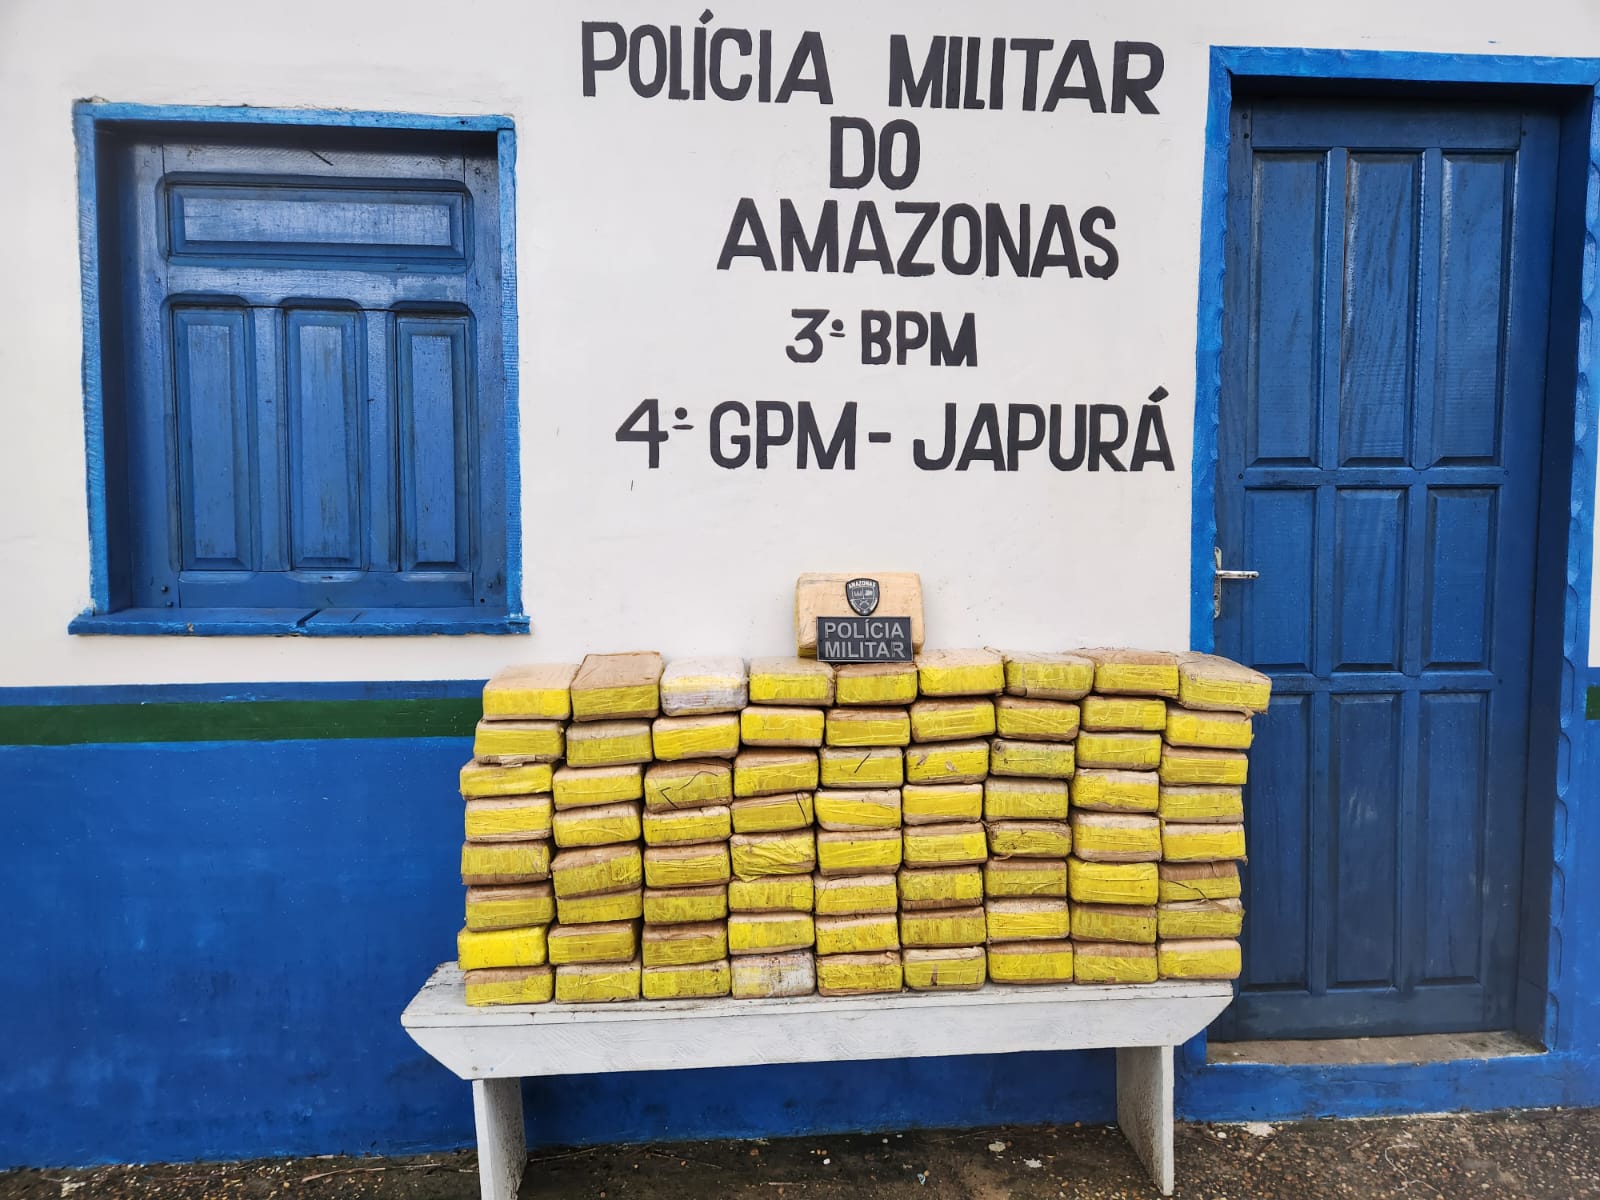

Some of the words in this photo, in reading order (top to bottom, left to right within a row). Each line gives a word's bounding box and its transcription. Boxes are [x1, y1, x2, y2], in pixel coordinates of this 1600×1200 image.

[582, 9, 833, 104] POLÍCIA
[889, 35, 1164, 114] MILITAR
[830, 116, 920, 190] DO
[717, 198, 1118, 280] AMAZONAS
[862, 310, 977, 366] BPM
[913, 386, 1174, 471] JAPURÁ
[824, 619, 904, 638] POLÍCIA
[825, 641, 905, 658] MILITAR
